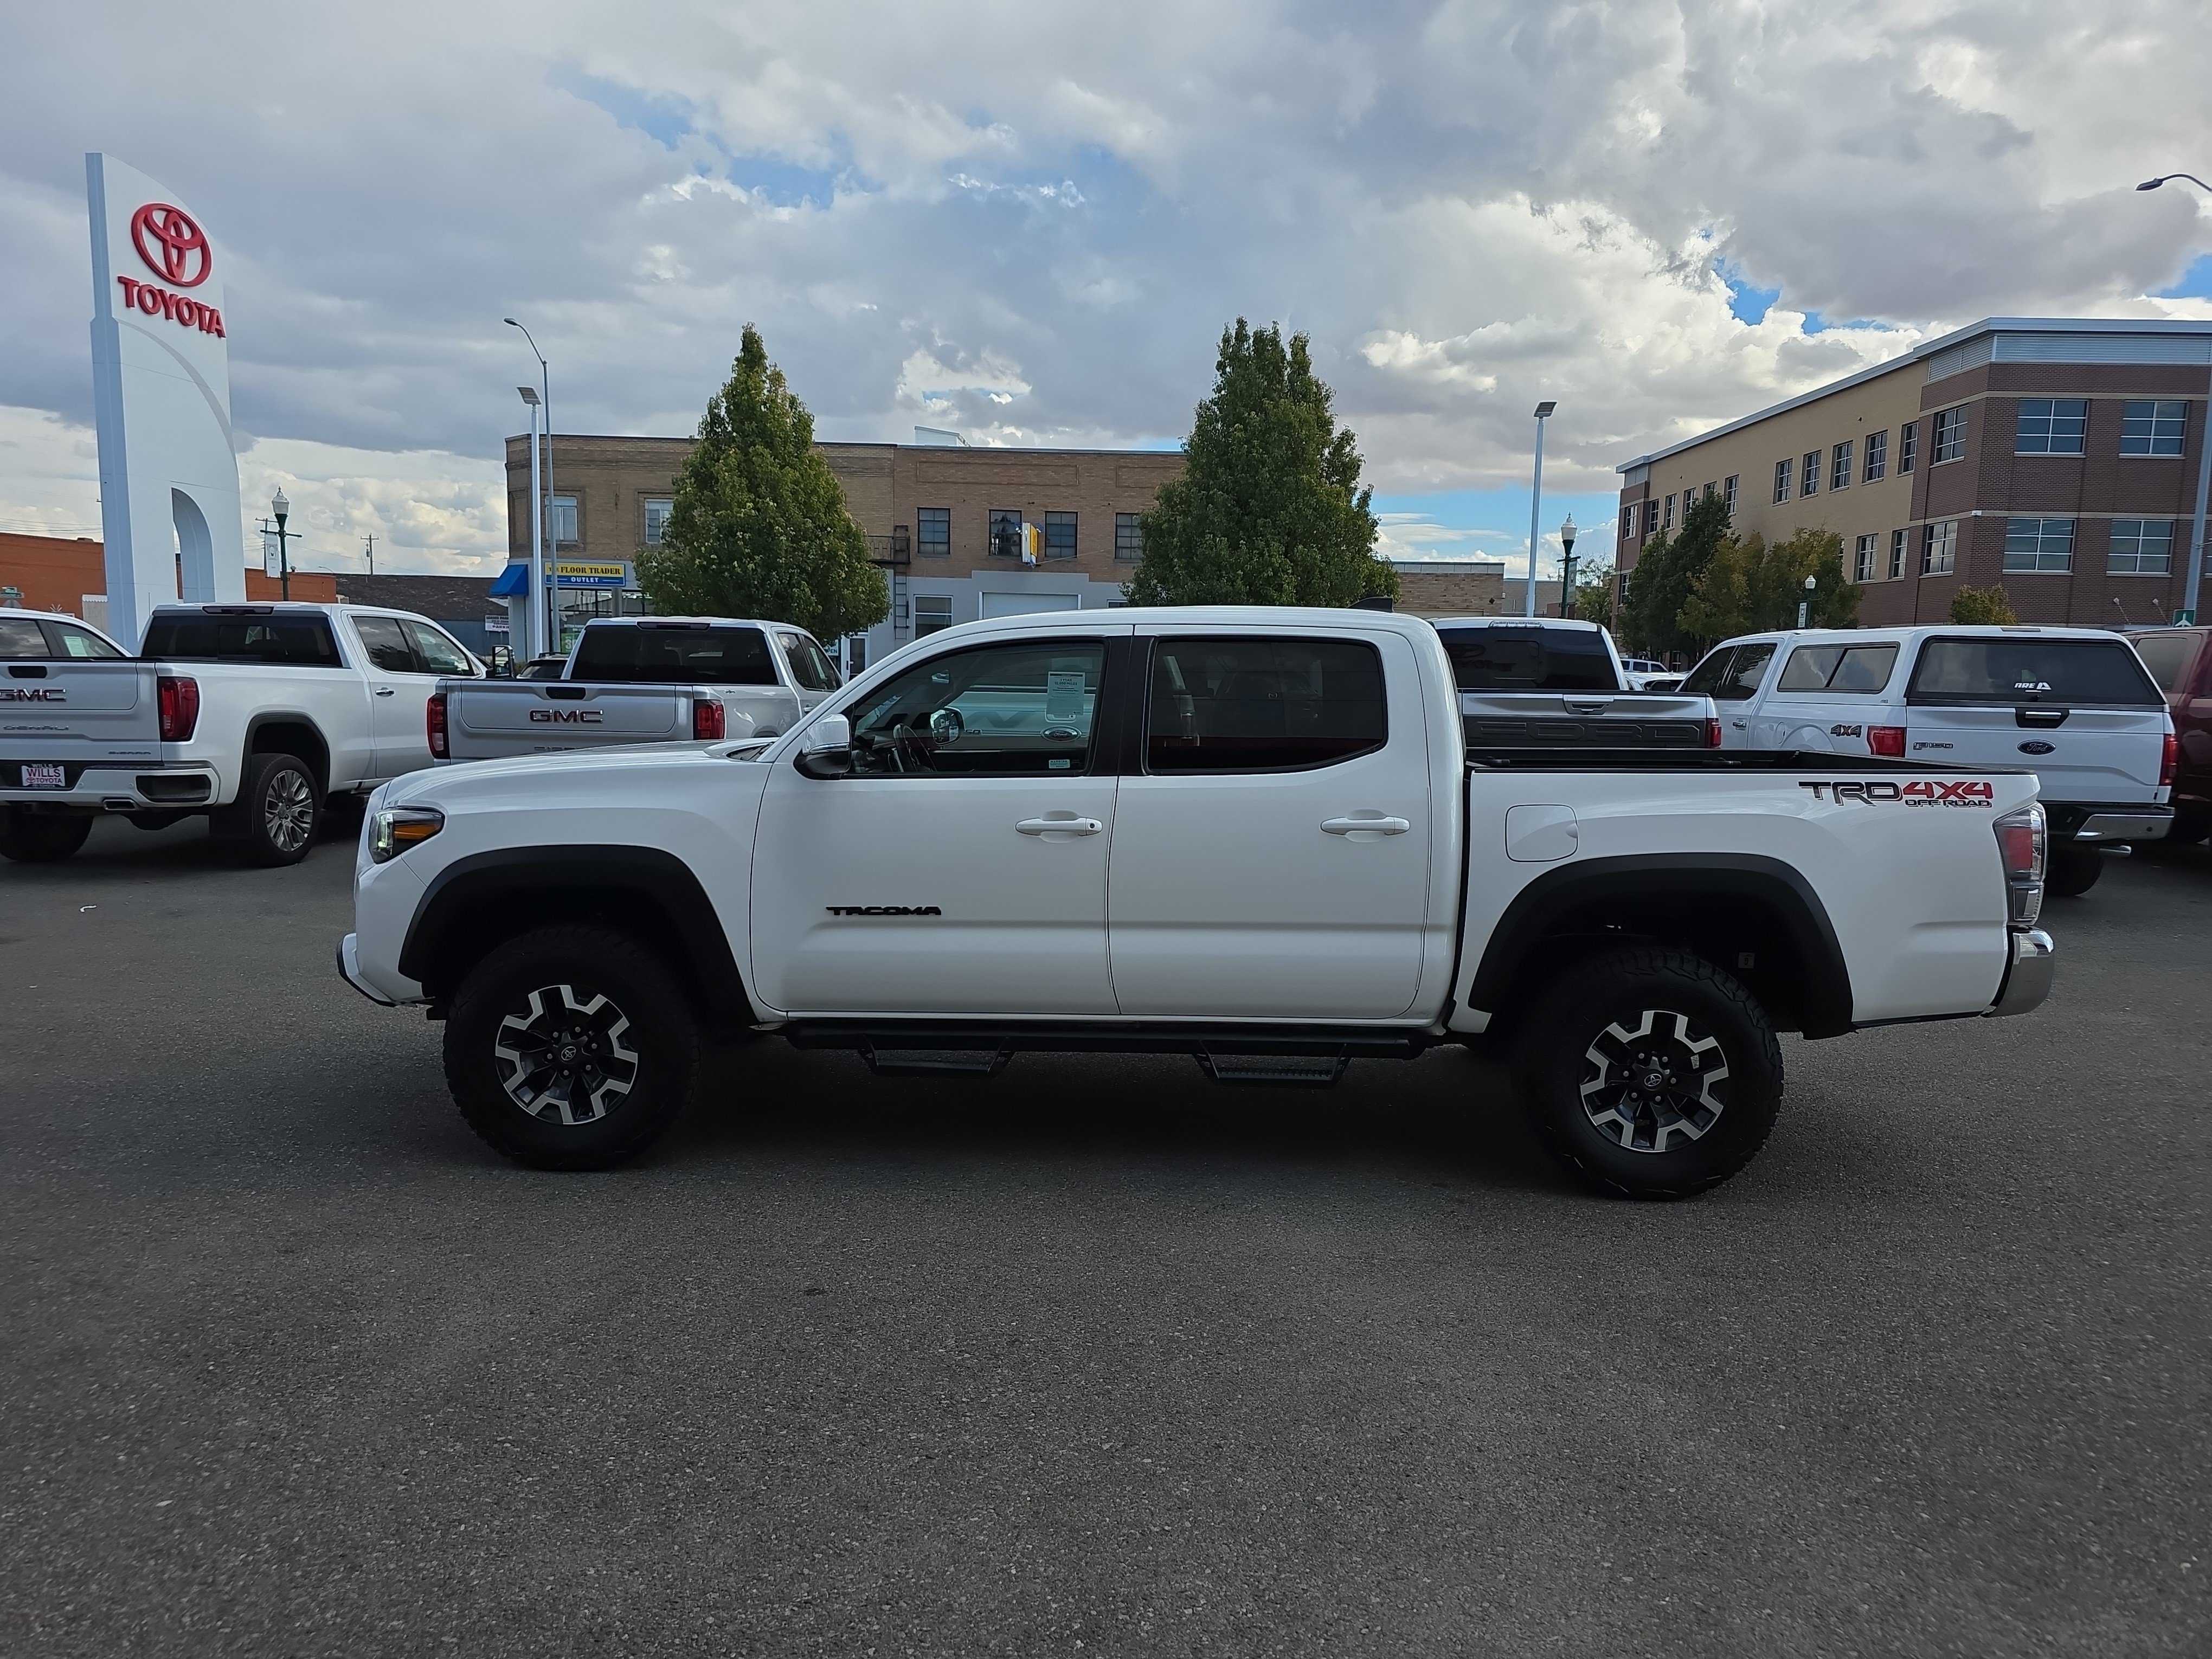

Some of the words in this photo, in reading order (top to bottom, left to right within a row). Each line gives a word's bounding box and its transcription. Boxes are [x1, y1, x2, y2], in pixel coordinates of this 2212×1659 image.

[118, 276, 226, 338] TOYOTA
[0, 688, 66, 702] GMC
[530, 709, 603, 723] GMC
[27, 768, 61, 777] WILLS
[1798, 781, 1903, 806] TRD
[1902, 781, 1994, 799] 4X4
[1905, 799, 1940, 807] OFF
[1943, 799, 1992, 808] ROAD
[826, 906, 942, 916] TACOMA
